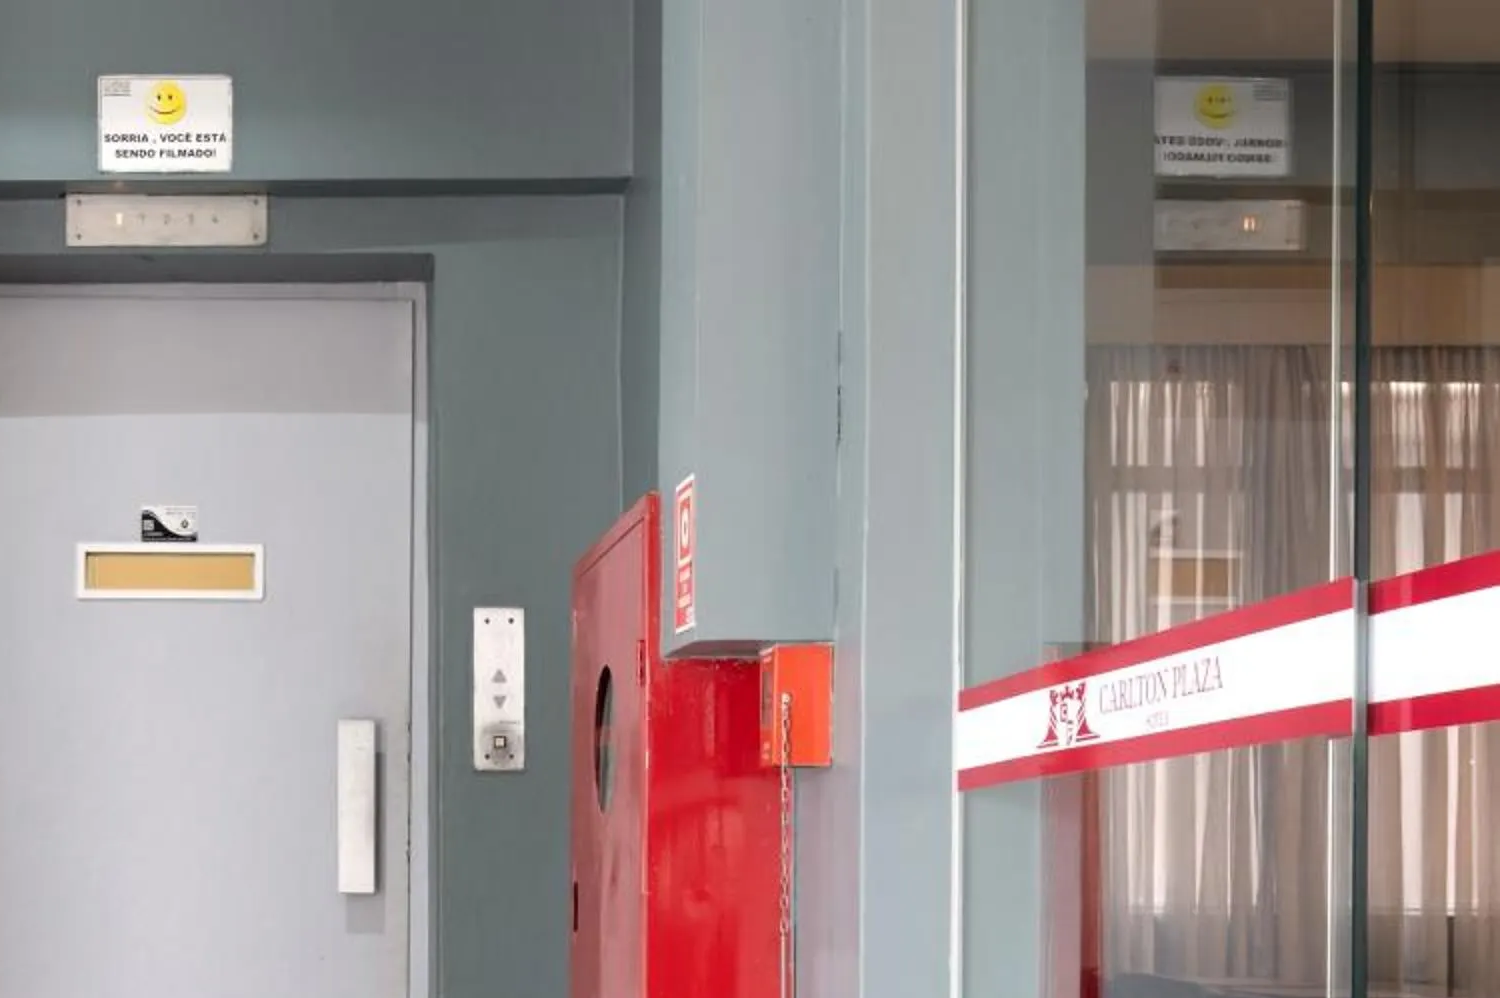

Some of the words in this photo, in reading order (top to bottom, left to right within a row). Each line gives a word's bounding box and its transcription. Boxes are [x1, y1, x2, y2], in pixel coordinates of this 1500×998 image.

[104, 132, 149, 143] SORRIA
[160, 131, 193, 143] VOCÊ
[115, 148, 156, 159] SENDO
[1099, 668, 1168, 715] CARLTON
[1172, 656, 1224, 699] PLAZA
